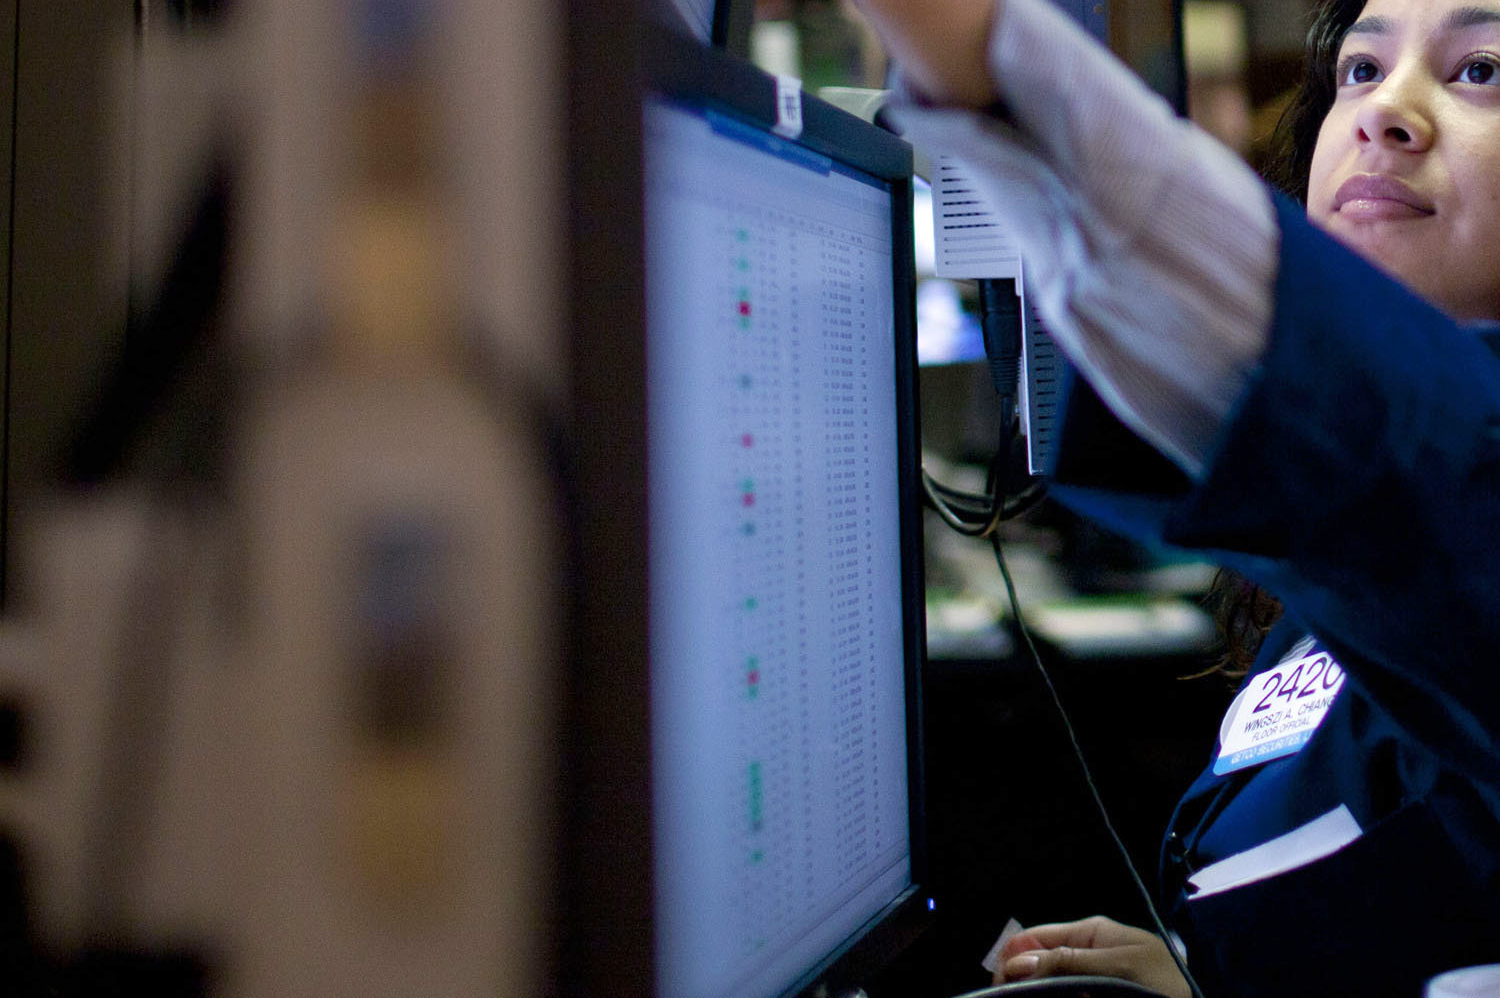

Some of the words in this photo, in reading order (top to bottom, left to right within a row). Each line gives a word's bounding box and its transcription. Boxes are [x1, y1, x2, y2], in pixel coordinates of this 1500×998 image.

[1252, 657, 1344, 714] 2420
[1252, 725, 1278, 742] FLOOR
[1279, 715, 1310, 734] OFFICIAL
